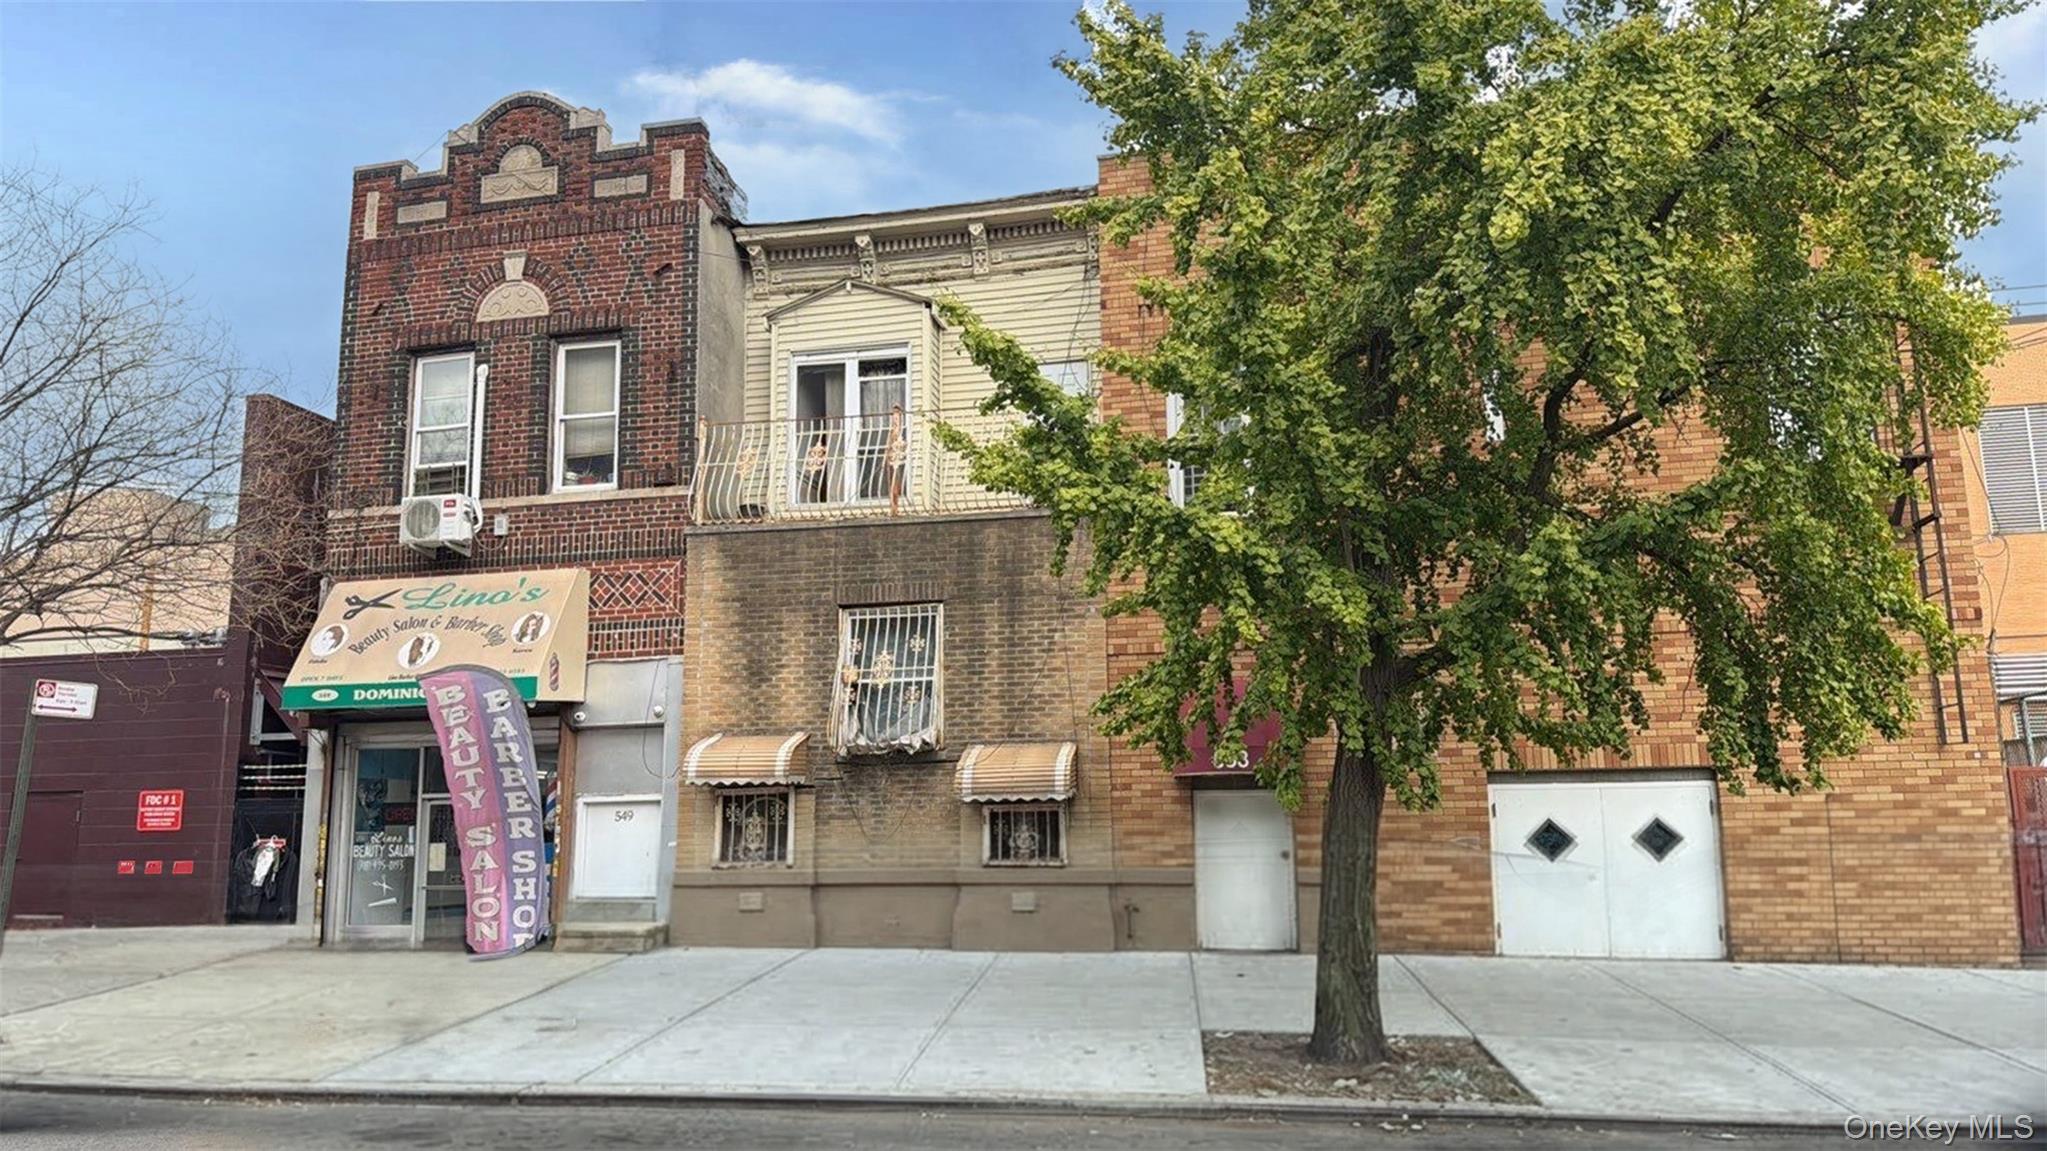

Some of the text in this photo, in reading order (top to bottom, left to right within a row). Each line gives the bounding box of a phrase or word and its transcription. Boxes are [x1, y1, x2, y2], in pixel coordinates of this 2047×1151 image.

[402, 577, 550, 610] Lino's
[348, 625, 392, 655] Beauty
[392, 615, 429, 634] Salon
[430, 614, 443, 629] &
[444, 615, 488, 634] Barber
[483, 688, 537, 840] BARBER
[434, 684, 500, 942] BEAUTY SALON
[614, 809, 635, 823] 549
[353, 843, 415, 858] BEAUTY SALON
